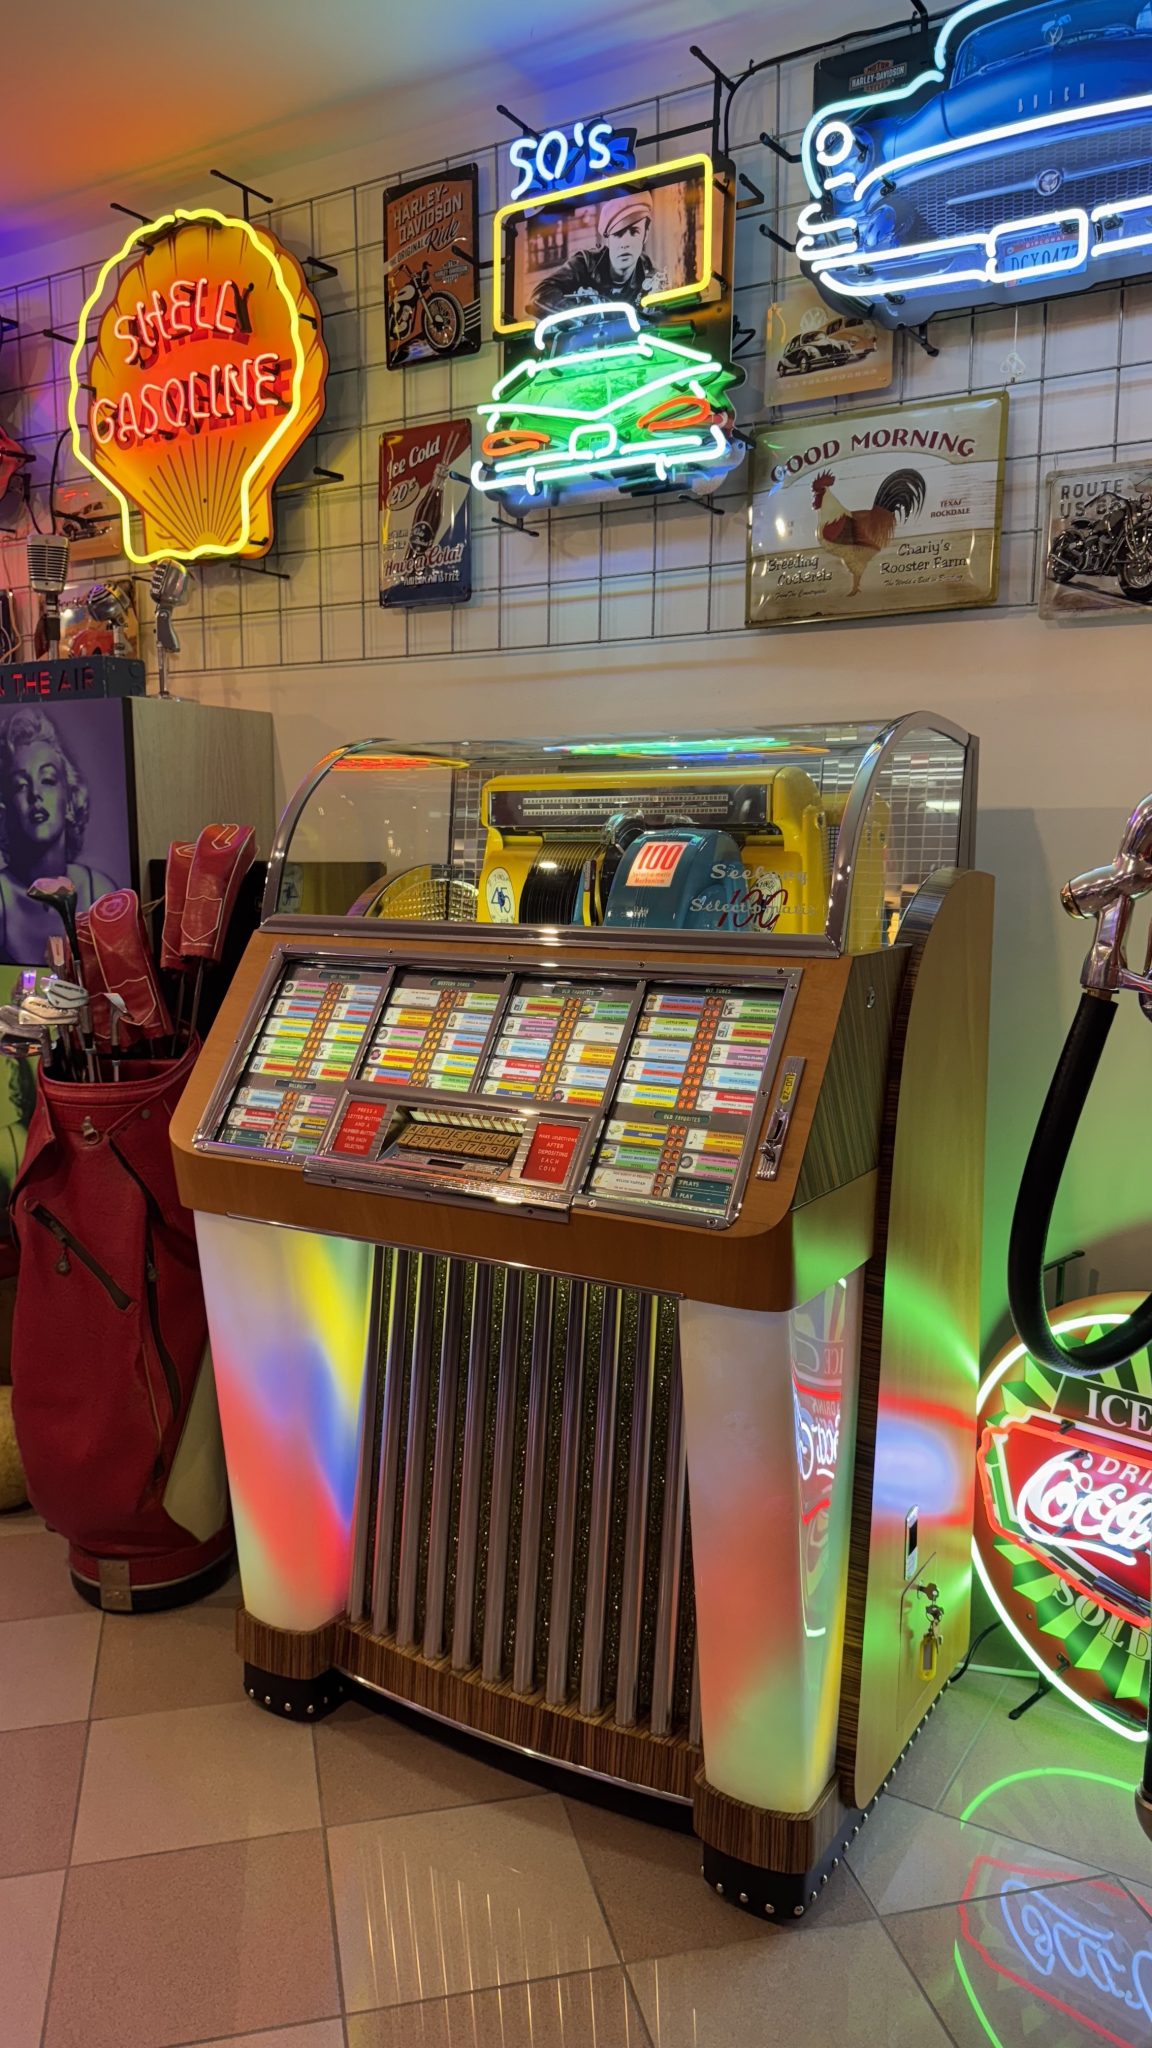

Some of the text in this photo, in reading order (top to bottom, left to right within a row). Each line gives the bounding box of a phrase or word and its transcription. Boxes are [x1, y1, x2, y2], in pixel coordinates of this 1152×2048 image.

[851, 65, 905, 88] HARLEY-DAVIDSON
[1018, 84, 1085, 112] BUICK
[393, 184, 449, 229] HARLEY-
[399, 191, 464, 246] DAVIDSON
[425, 217, 461, 253] Ride
[1025, 234, 1066, 248] DIPLOMAT
[115, 277, 238, 364] SHELL
[91, 352, 281, 445] GASOLINE
[851, 428, 976, 458] MORNING
[387, 435, 441, 481] Ice Cold
[1060, 478, 1124, 500] ROUTE
[930, 508, 970, 518] ROCKDALE
[1060, 501, 1086, 518] US
[385, 543, 465, 577] Have a Cola!
[768, 553, 820, 572] Breeding
[880, 556, 968, 575] Rooster Farm
[11, 671, 51, 696] THE
[58, 666, 95, 692] AIR
[637, 844, 684, 870] 100
[675, 1114, 701, 1123] FAVORITES
[537, 1149, 569, 1158] DEPOSITING
[539, 1157, 560, 1165] EACH
[683, 1180, 700, 1188] PLAYS
[1085, 1387, 1152, 1436] ICE
[1096, 1456, 1152, 1489] DRI
[1053, 1577, 1151, 1661] SOLD
